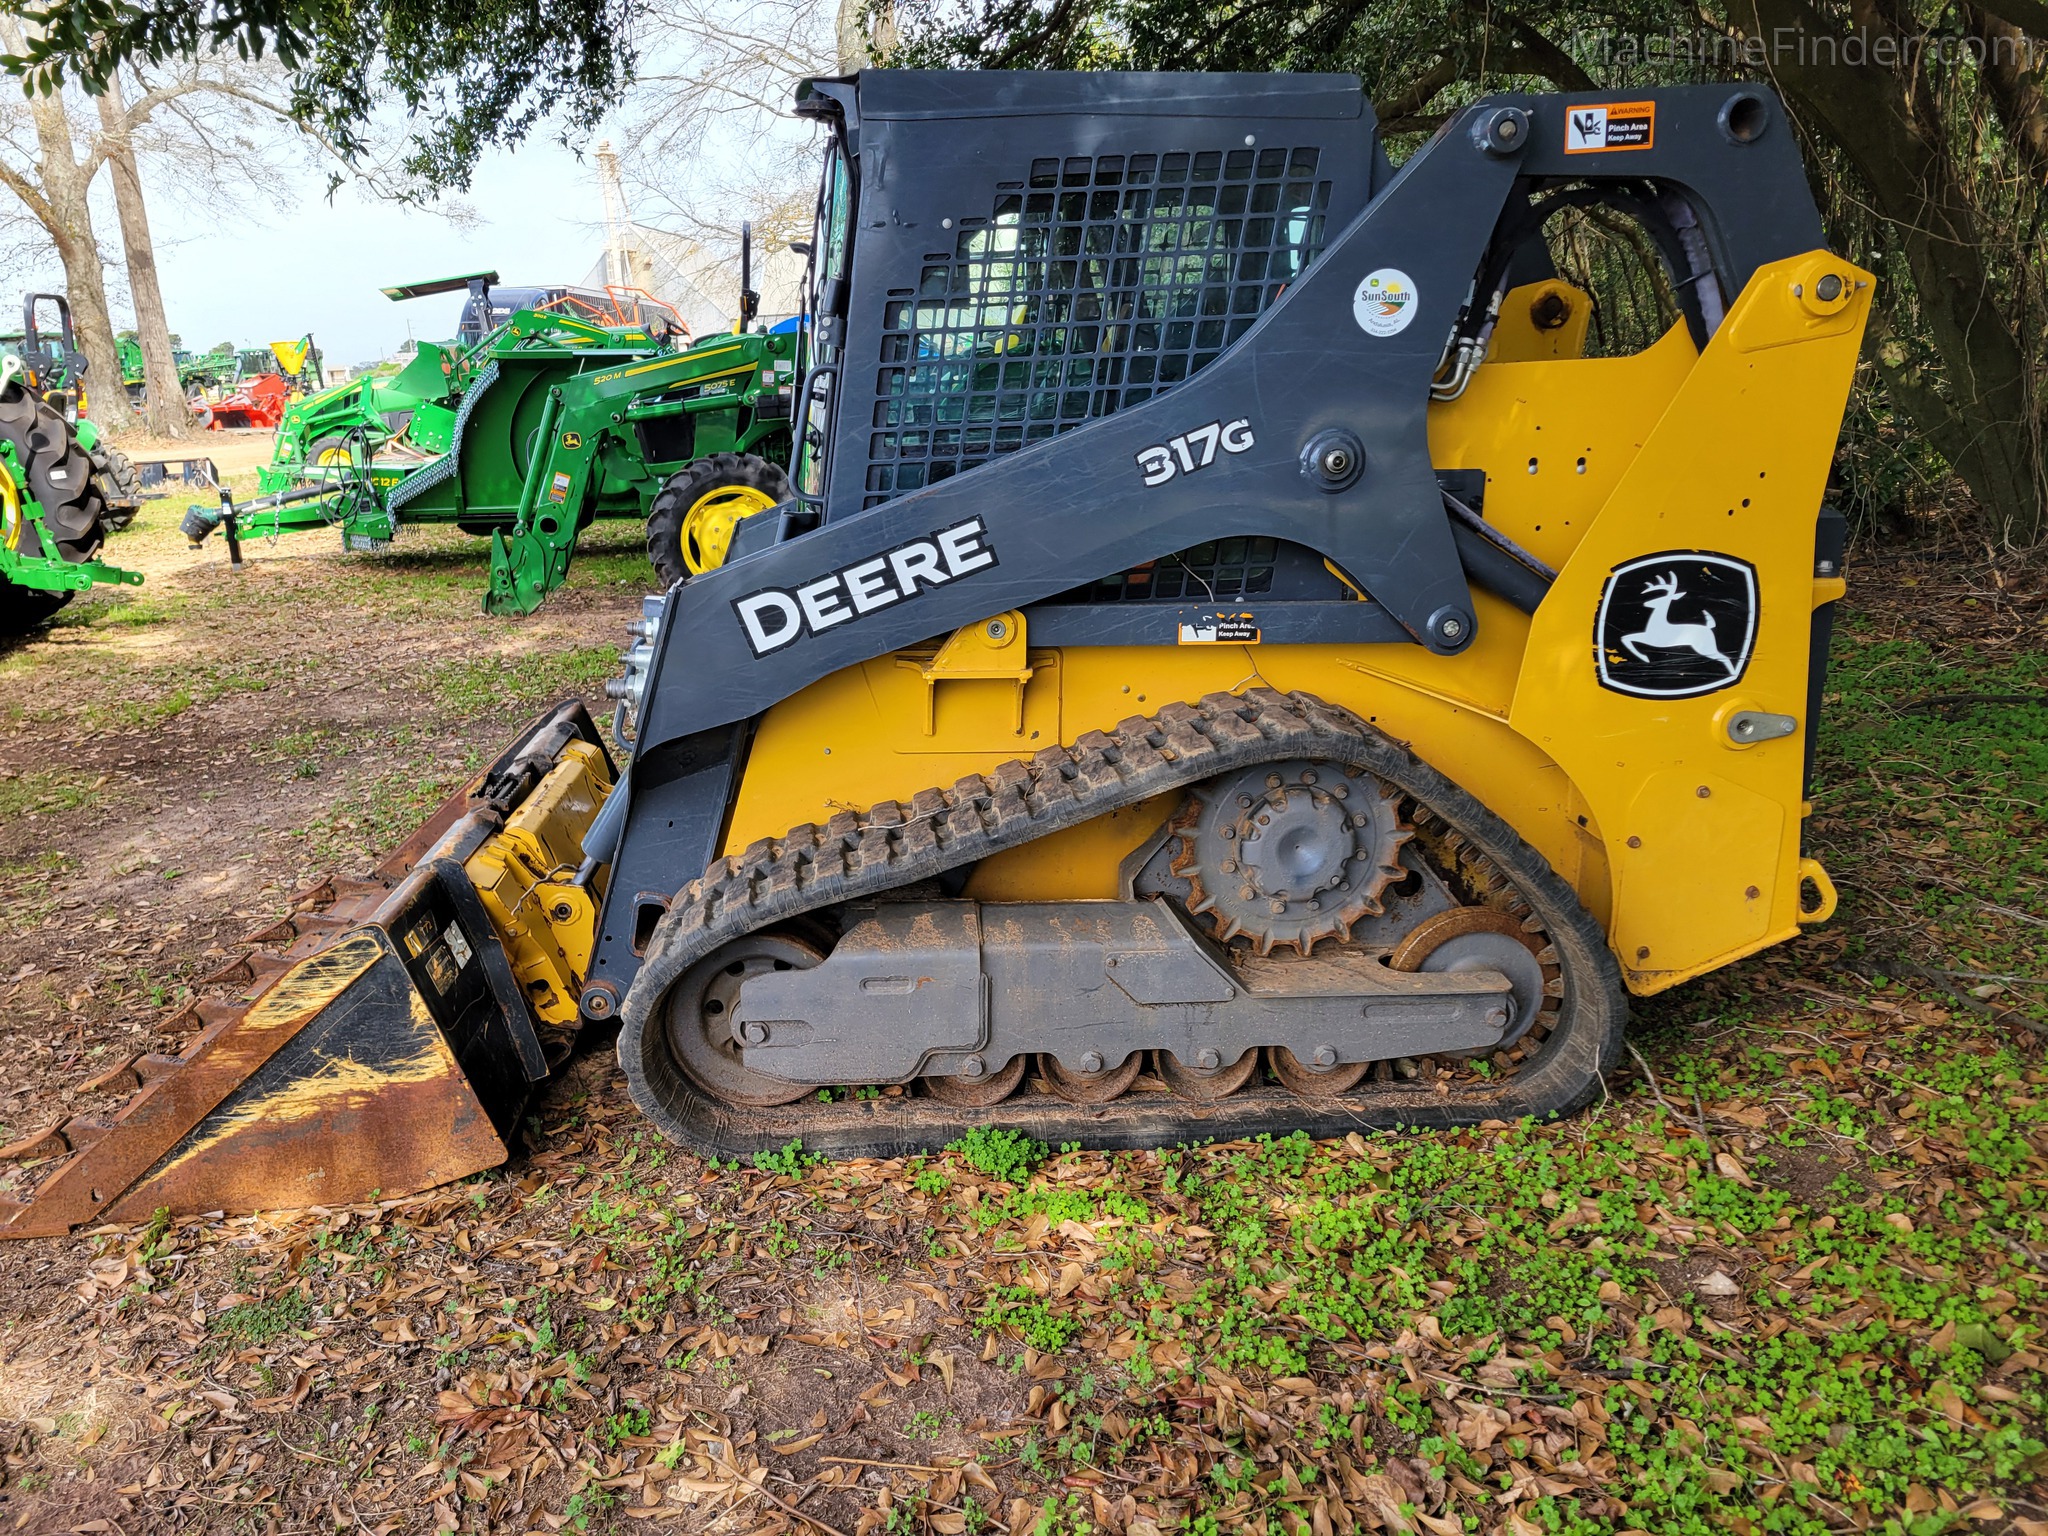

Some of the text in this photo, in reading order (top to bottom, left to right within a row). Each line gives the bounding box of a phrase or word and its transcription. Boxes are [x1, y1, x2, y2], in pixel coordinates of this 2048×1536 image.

[1617, 107, 1650, 115] WARNING
[1608, 122, 1648, 132] Pinch Area
[1607, 133, 1642, 142] Keep Away
[1361, 290, 1411, 302] SunSouth
[1136, 418, 1255, 486] 317G
[736, 519, 994, 655] DEERE
